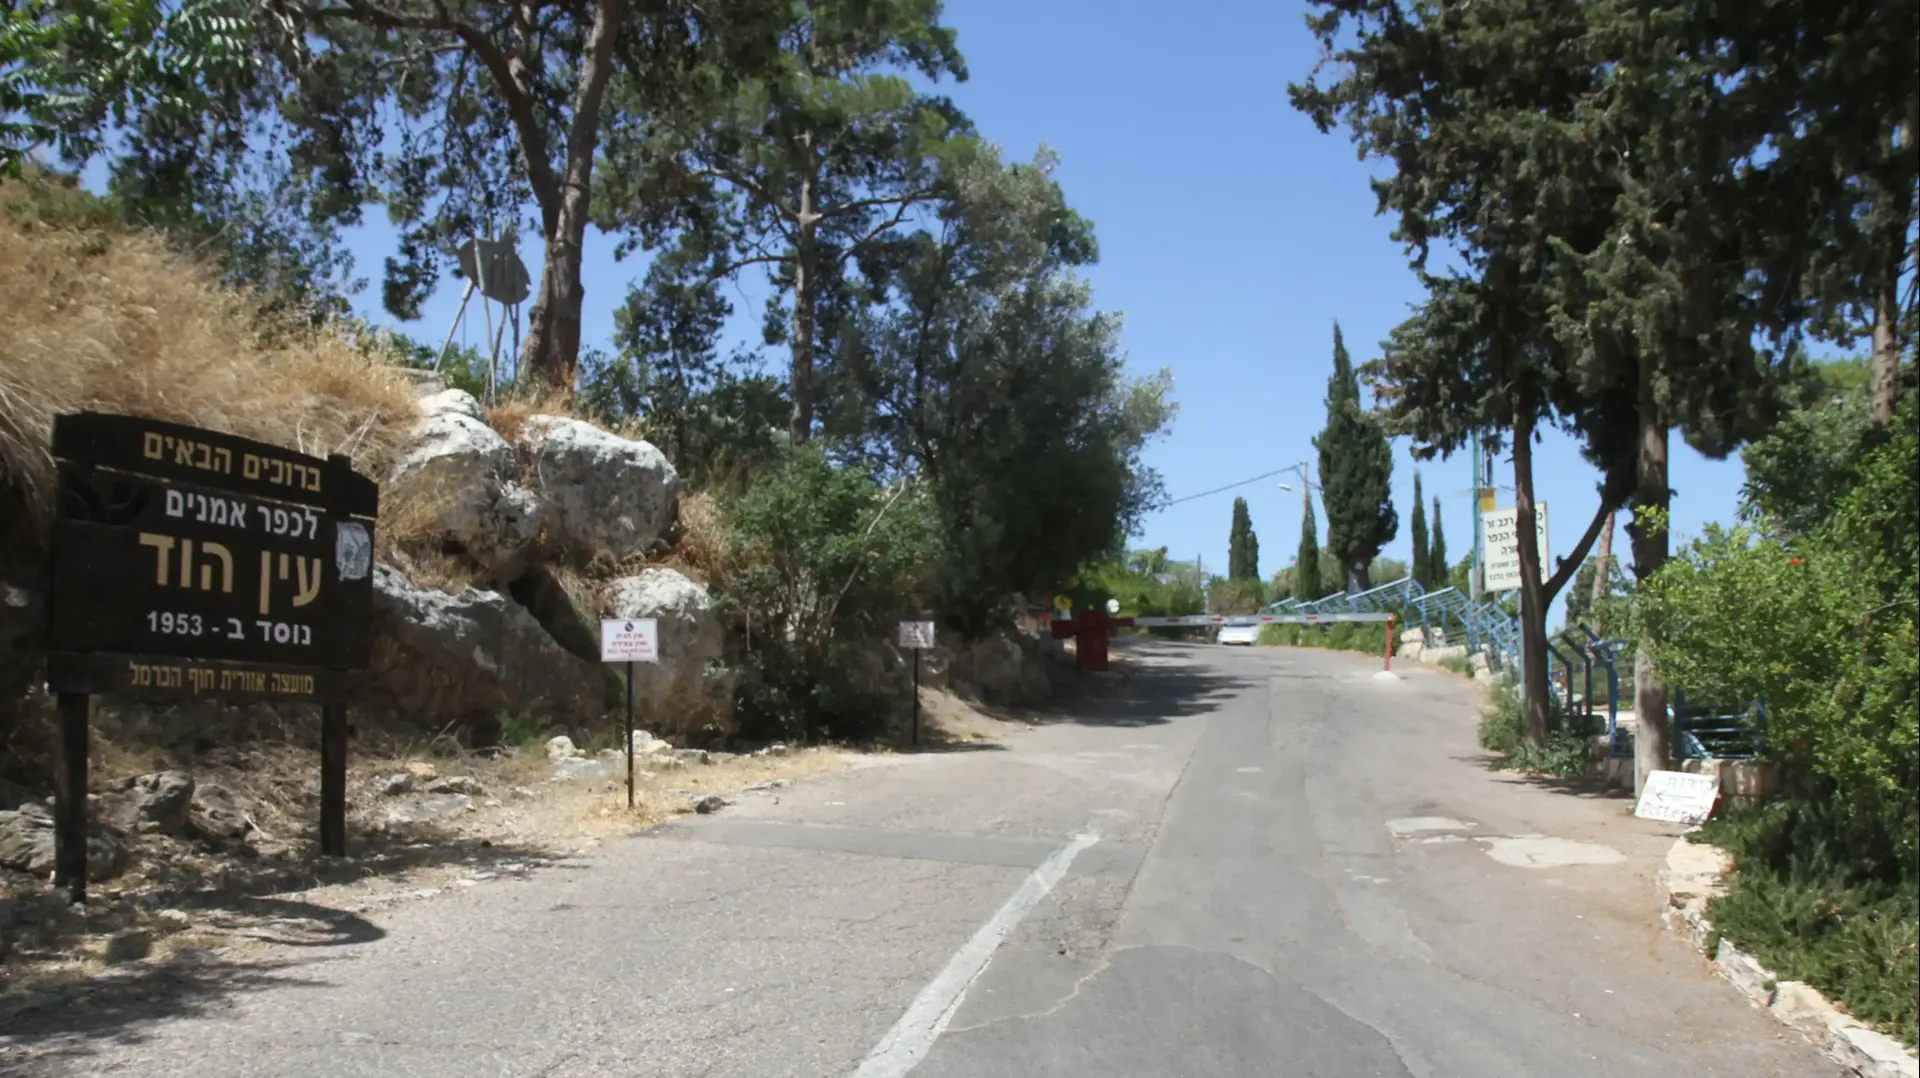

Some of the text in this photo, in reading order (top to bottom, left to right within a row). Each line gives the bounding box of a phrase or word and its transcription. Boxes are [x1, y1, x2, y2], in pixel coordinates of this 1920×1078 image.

[143, 431, 321, 492] ברוכים הבאים
[165, 489, 318, 540] לכפר אמנים
[139, 532, 321, 614] עין הוד
[147, 610, 203, 636] 1953
[227, 617, 245, 640] ב
[256, 620, 312, 646] נוסד
[128, 660, 315, 695] מועצה אזורית חוף הכרמל
